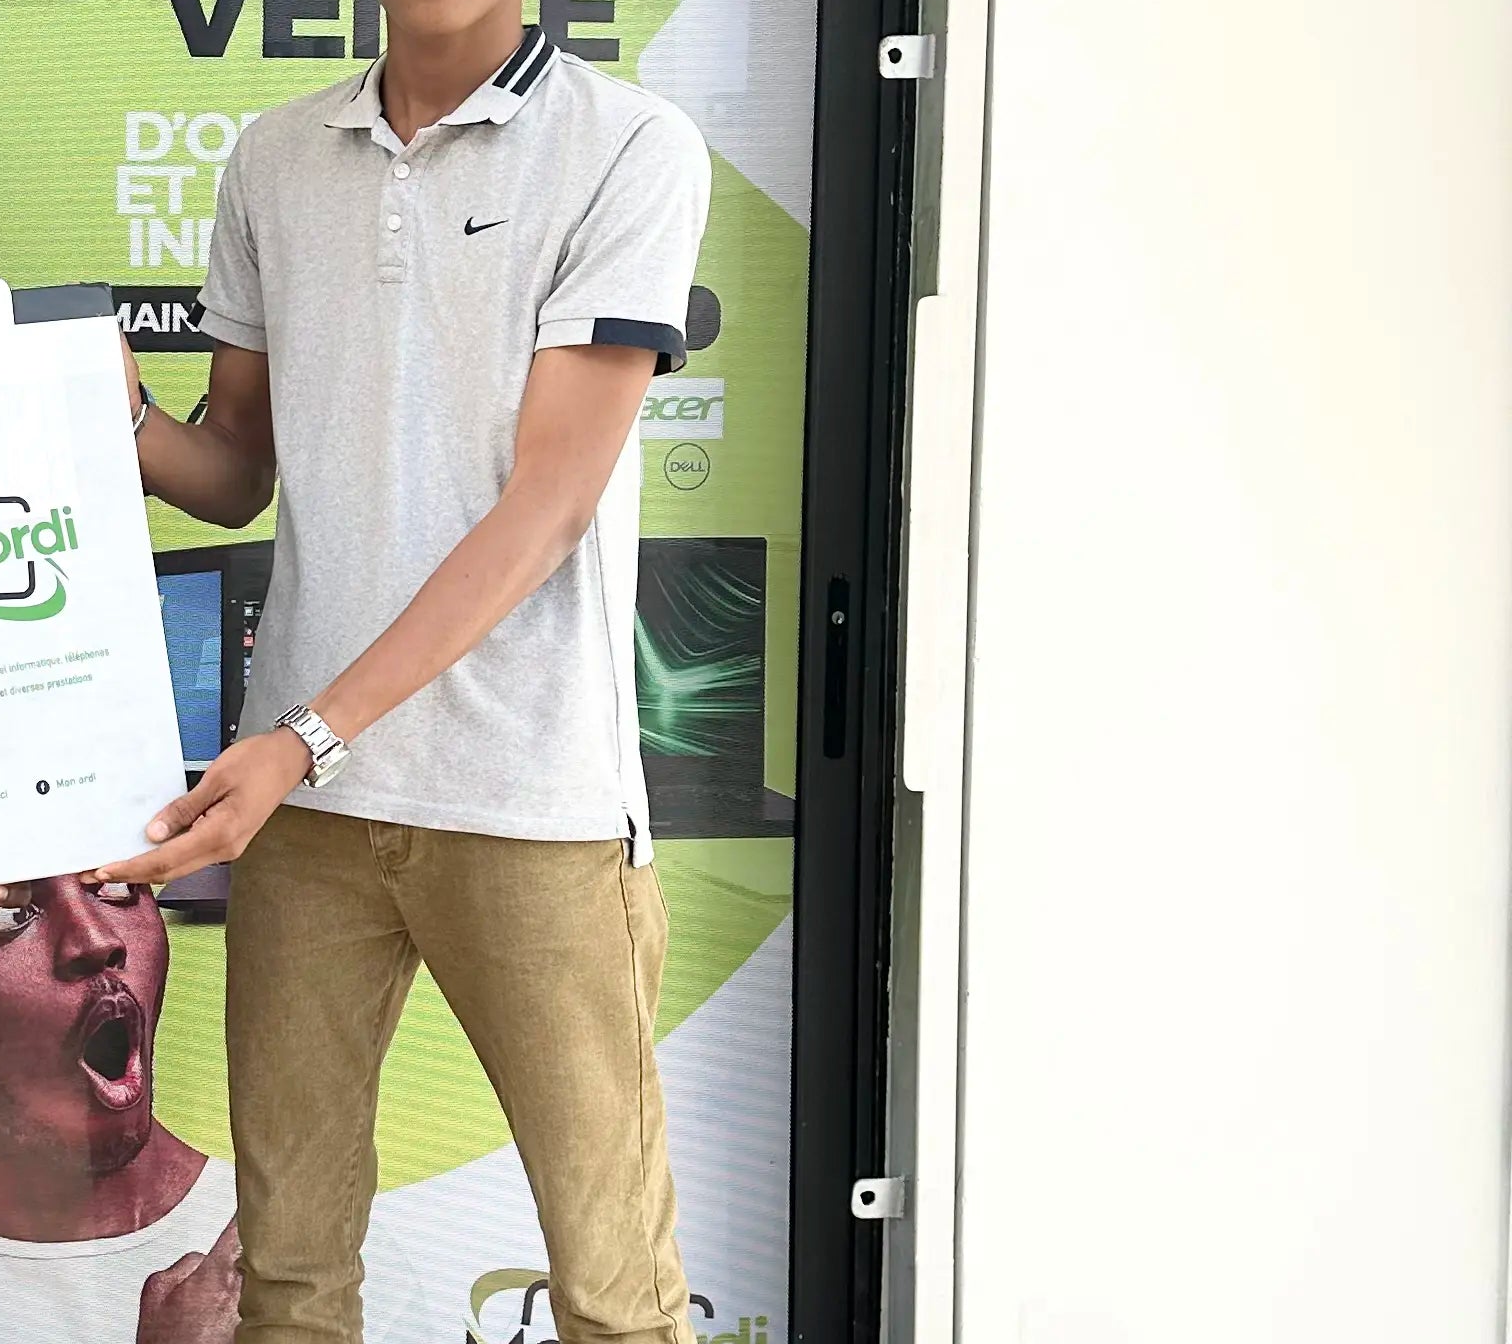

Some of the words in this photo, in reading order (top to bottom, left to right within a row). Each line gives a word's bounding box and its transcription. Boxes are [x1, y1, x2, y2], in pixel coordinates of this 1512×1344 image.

[117, 165, 196, 215] ET
[117, 302, 200, 333] MAIN
[640, 396, 724, 421] acer
[669, 461, 706, 473] DELL
[0, 688, 8, 698] et
[10, 683, 45, 696] diverses
[47, 674, 93, 691] prestations
[56, 778, 76, 788] Mon
